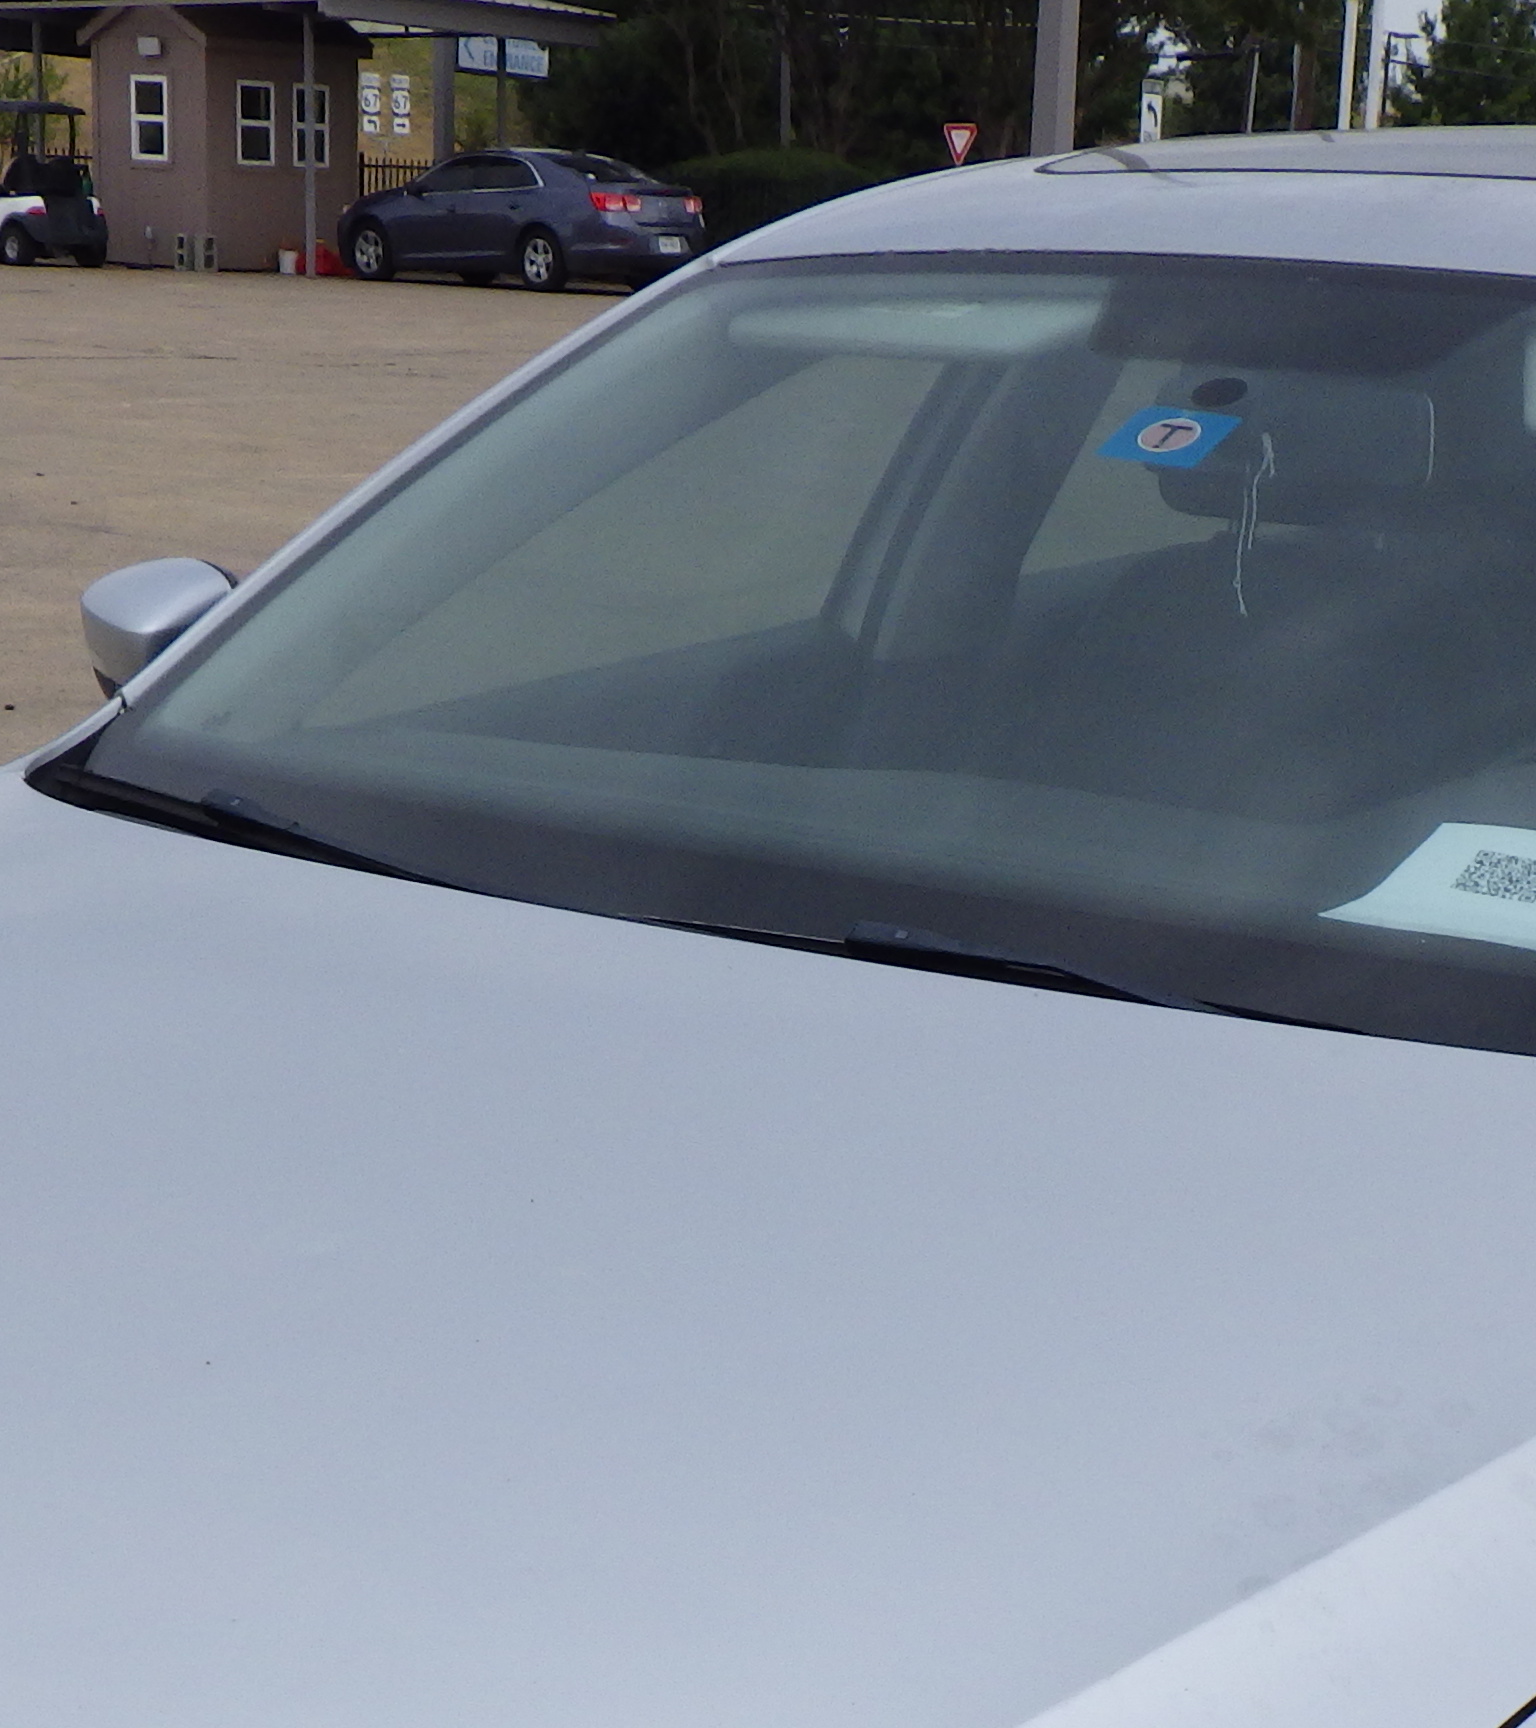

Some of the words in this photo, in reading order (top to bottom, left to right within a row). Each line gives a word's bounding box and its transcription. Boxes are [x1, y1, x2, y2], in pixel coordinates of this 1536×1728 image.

[483, 50, 545, 74] ENRANCE
[364, 94, 378, 108] 67
[394, 95, 408, 109] 67
[1152, 423, 1193, 448] T
